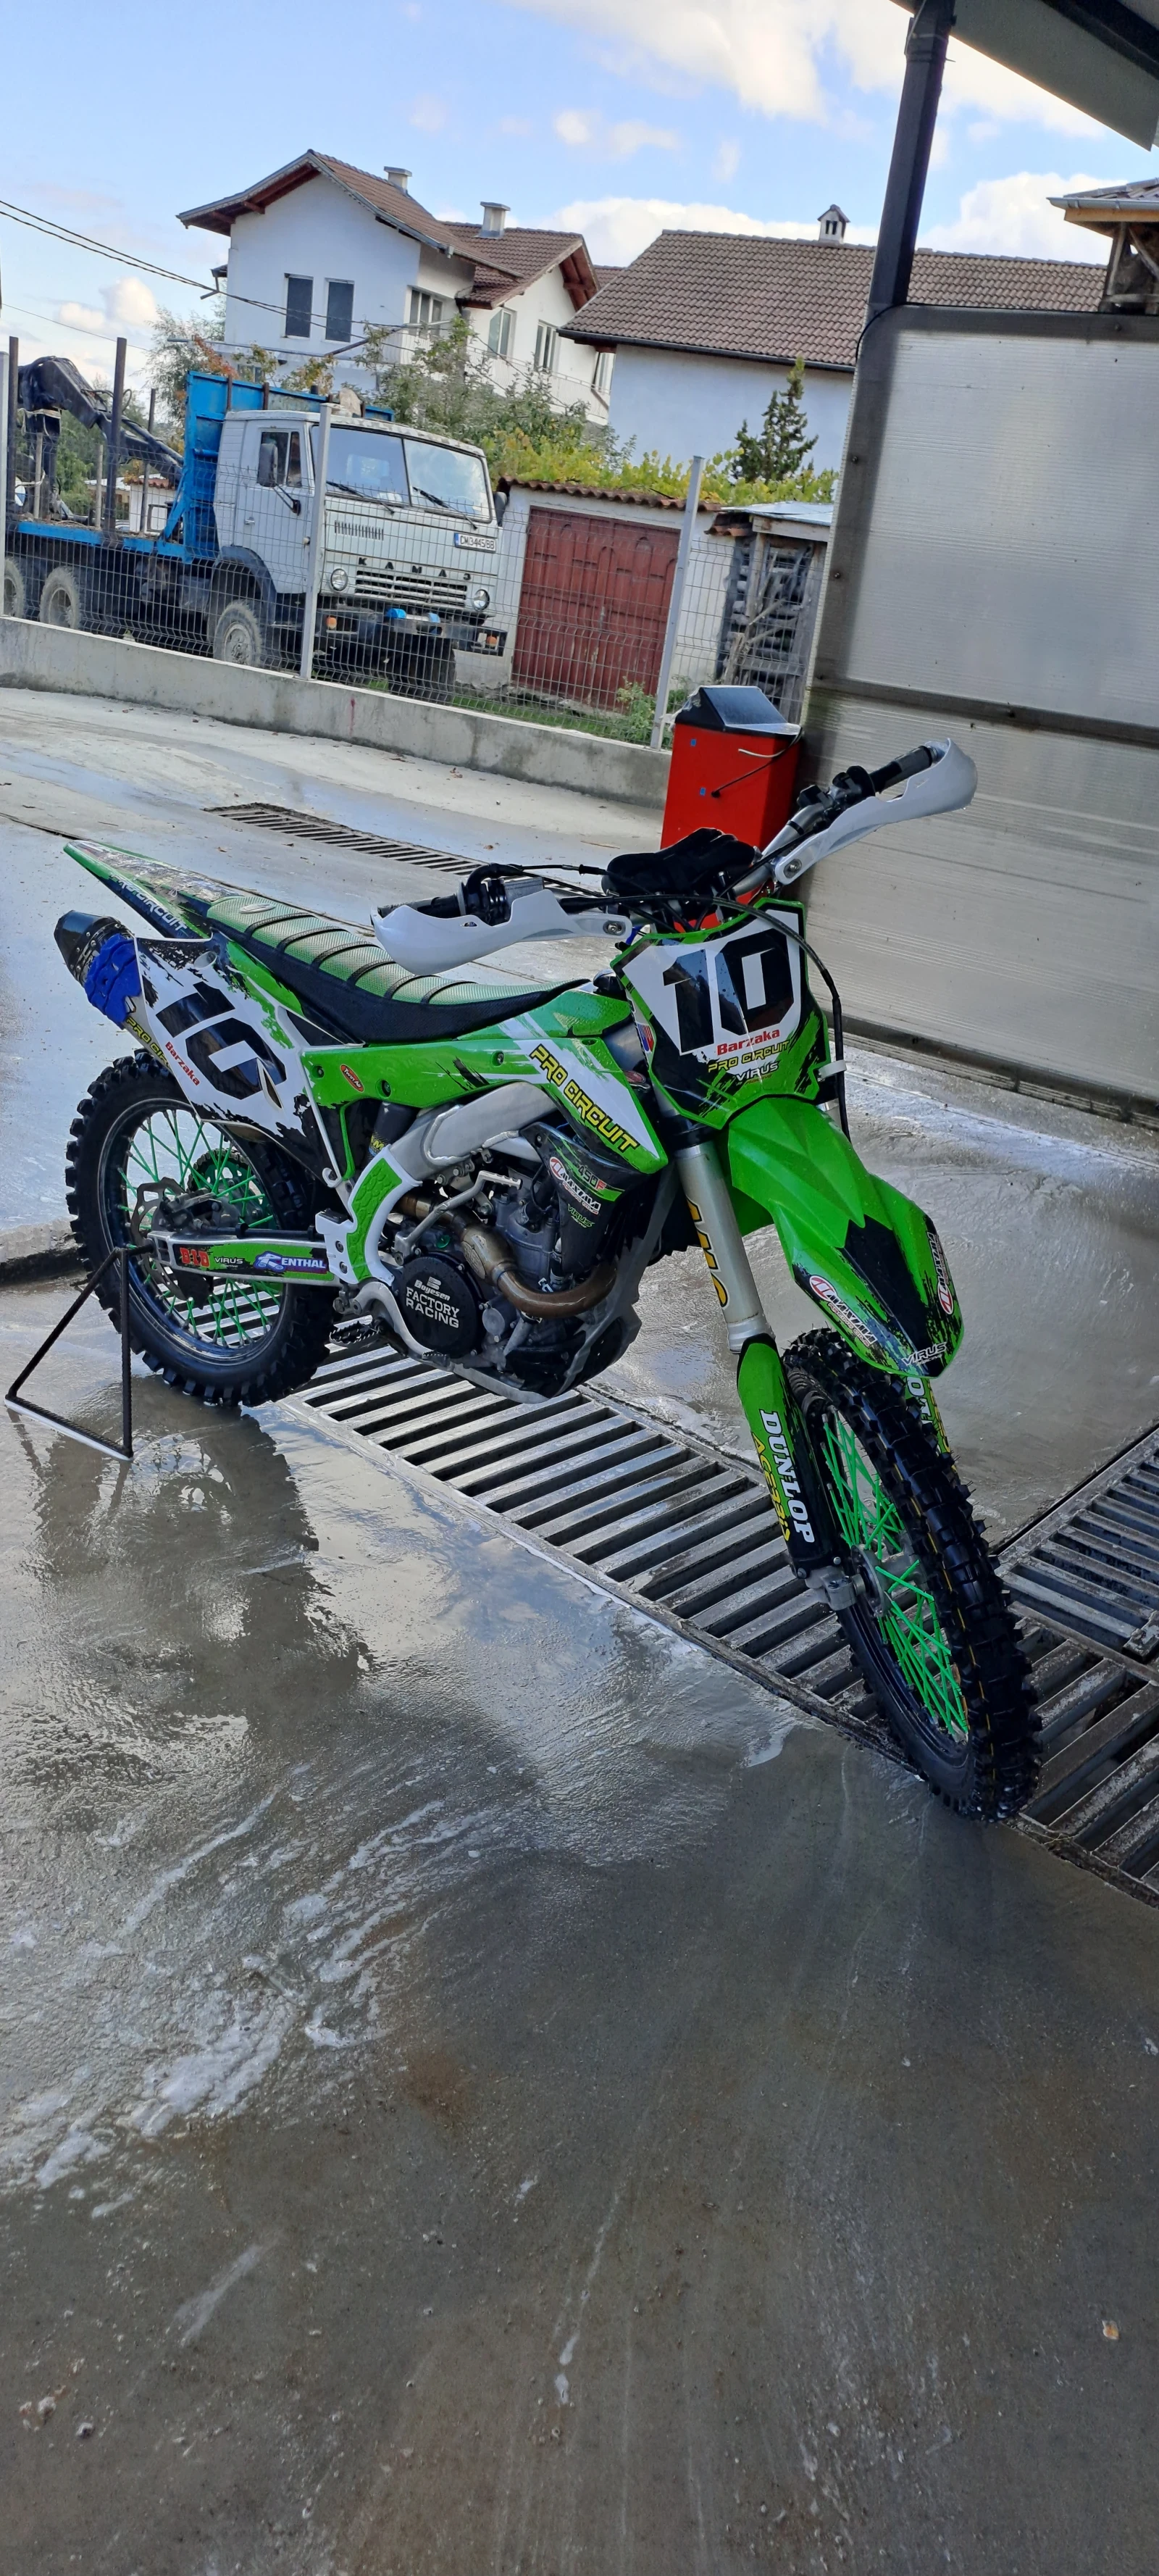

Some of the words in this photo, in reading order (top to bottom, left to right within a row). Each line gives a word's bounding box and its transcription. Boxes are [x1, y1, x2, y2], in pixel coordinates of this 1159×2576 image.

[135, 892, 188, 931] CIRCUIT
[663, 928, 795, 1053] 10
[126, 1016, 153, 1044] PRO
[156, 981, 287, 1100] 10
[716, 1028, 781, 1056] Barzaka
[165, 1041, 200, 1086] Barzaka
[707, 1055, 740, 1073] PRO
[740, 1040, 790, 1064] CIRCUIT
[736, 1061, 781, 1082] VIRUS
[344, 1067, 356, 1082] Twin
[353, 1080, 362, 1088] Air
[530, 1043, 568, 1087] PRO
[564, 1079, 640, 1153] CIRCUIT
[567, 1203, 595, 1227] VIRUS
[406, 1286, 460, 1318] FACTORY
[414, 1279, 451, 1301] Boyesen
[406, 1297, 459, 1328] RACING
[900, 1341, 947, 1366] VIRUS
[758, 1409, 815, 1543] DUNLOP
